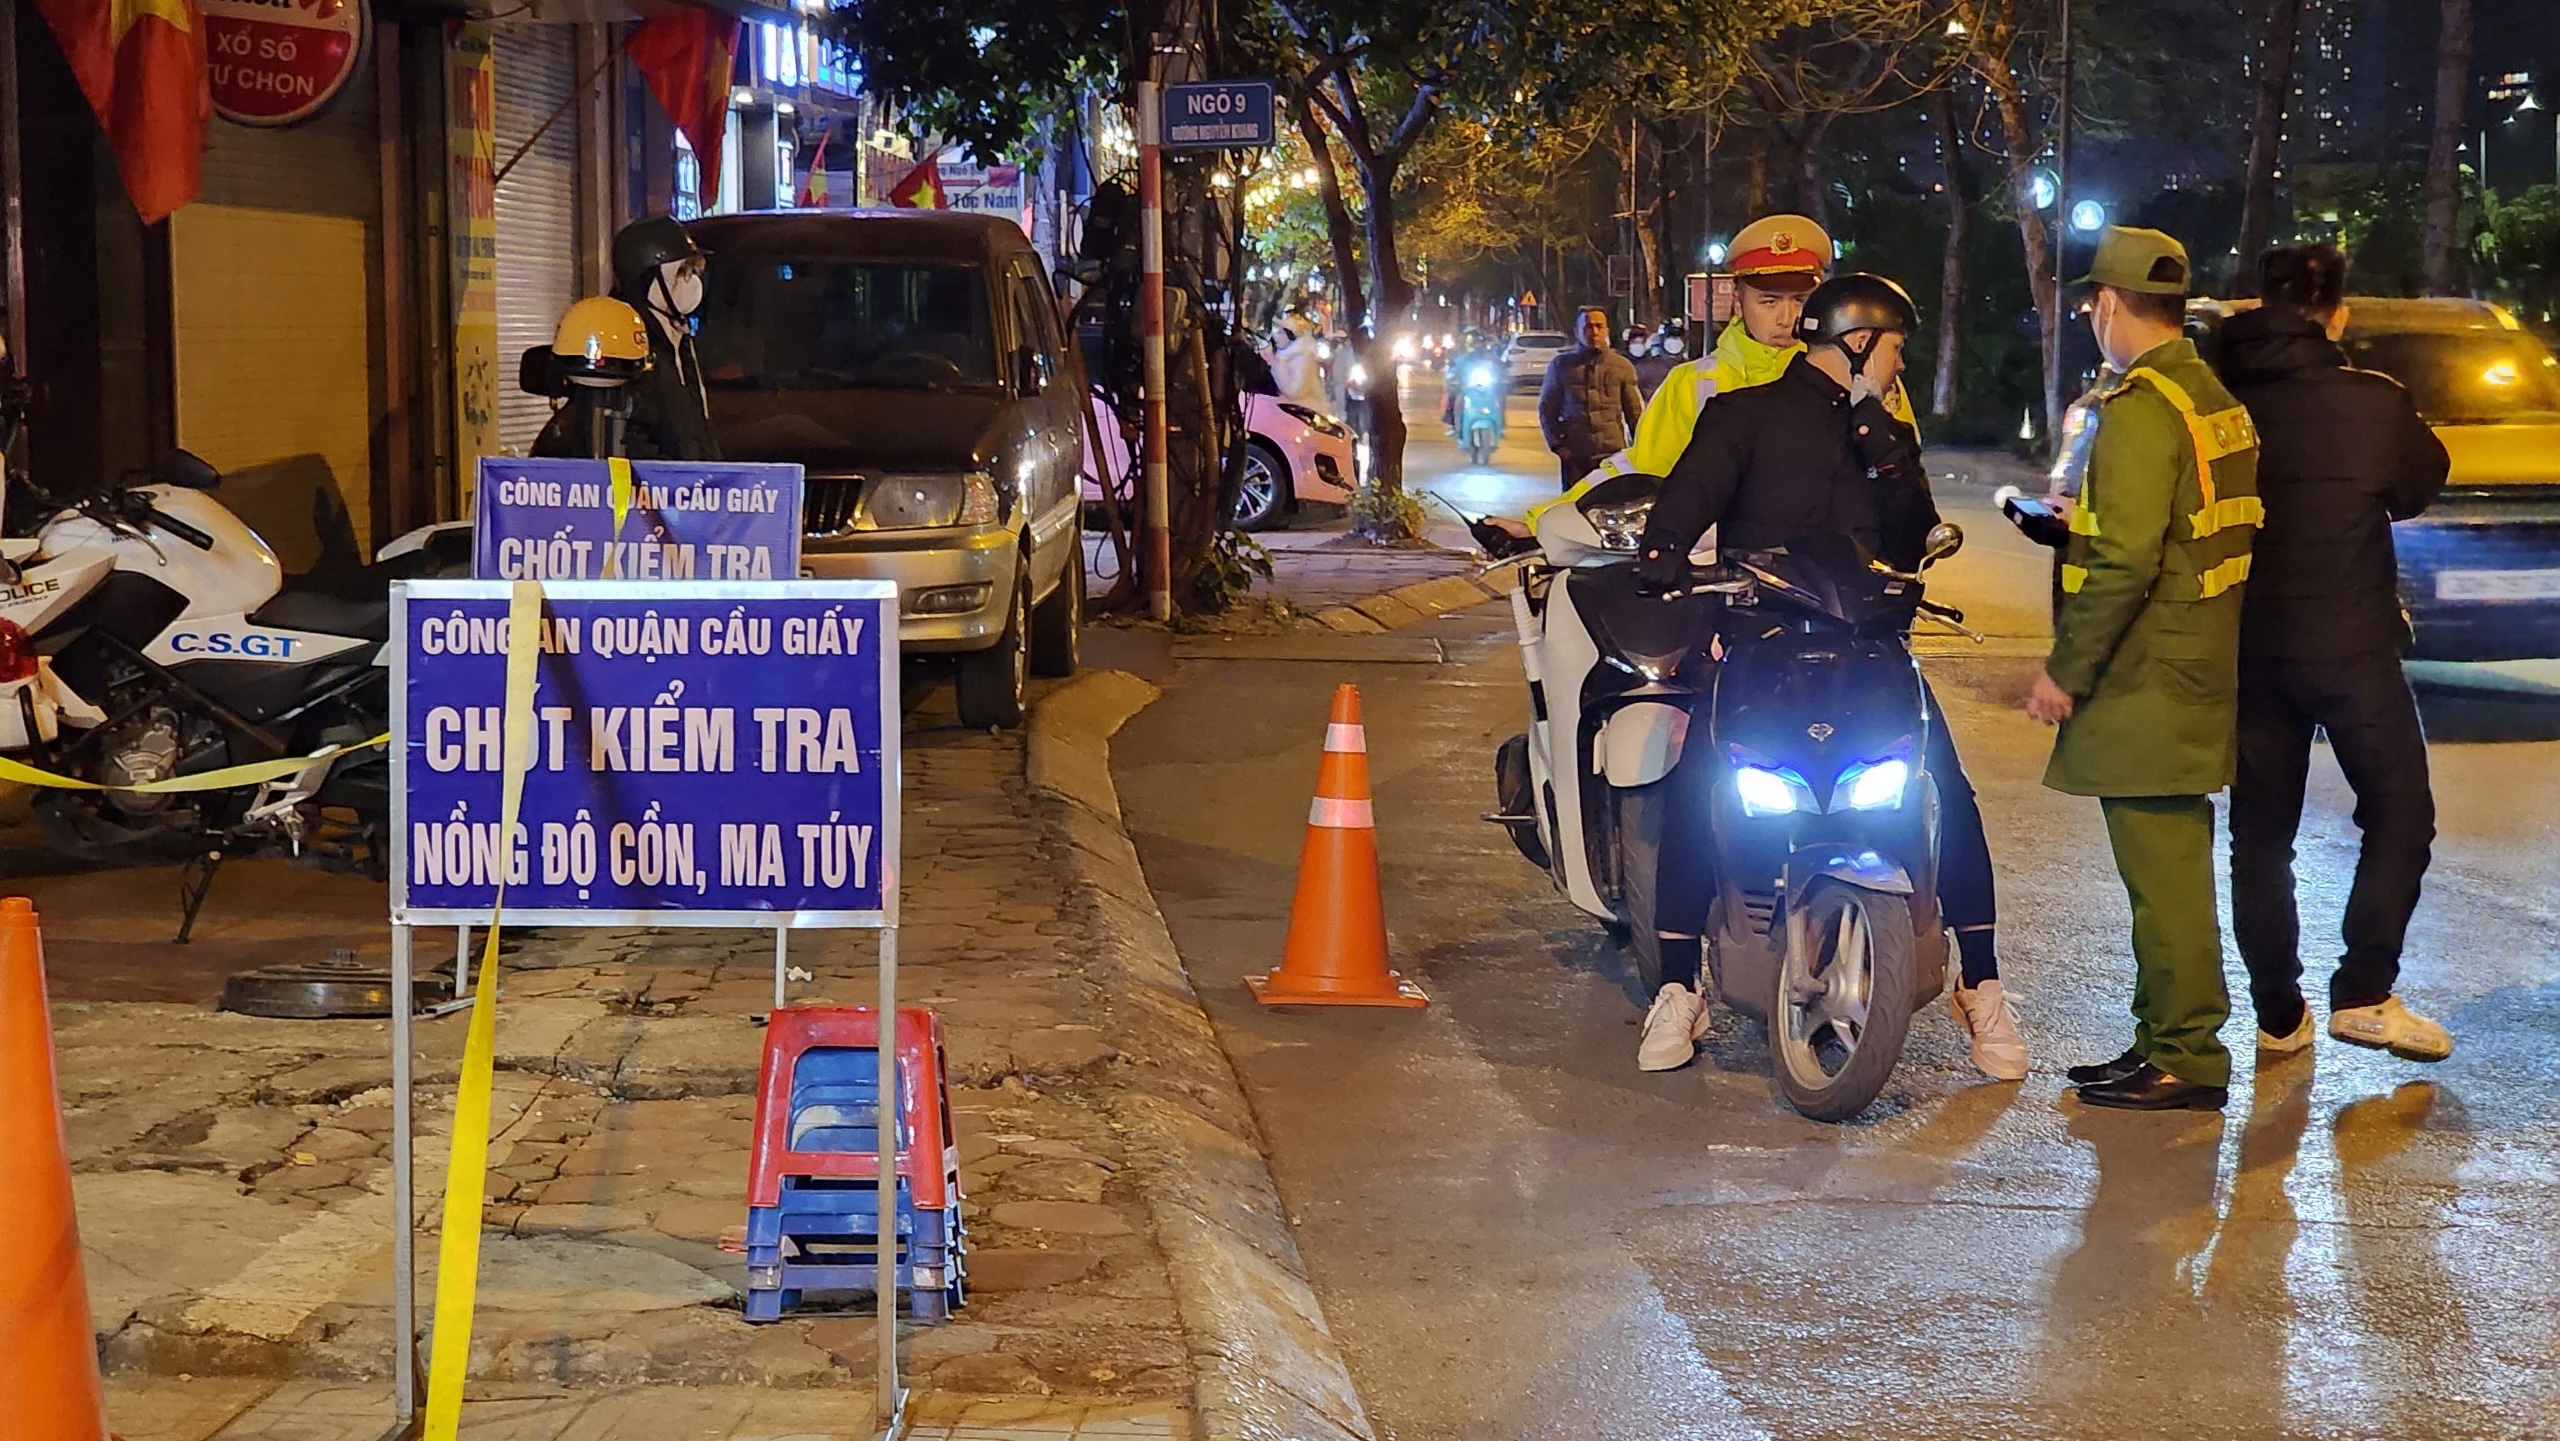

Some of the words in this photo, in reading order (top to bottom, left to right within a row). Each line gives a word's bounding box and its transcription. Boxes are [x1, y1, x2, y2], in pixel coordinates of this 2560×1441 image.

[260, 33, 298, 61] SỐ
[237, 68, 314, 98] CHỌN
[1187, 88, 1231, 115] NGÕ
[1234, 93, 1247, 113] 9
[984, 192, 1018, 209] Nam
[500, 477, 561, 507] CÔNG
[567, 483, 600, 508] AN
[675, 474, 720, 511] CẦU
[727, 480, 779, 513] GIẤY
[500, 525, 592, 580] CHỐT
[603, 525, 695, 580] KIỂM
[707, 544, 772, 580] TRA
[0, 578, 60, 602] OLICE
[171, 633, 296, 658] C.S.G.T
[592, 610, 690, 662] QUẬN
[702, 605, 771, 655] CẦU
[782, 604, 864, 656] GIẤY
[591, 679, 735, 773] KIỂM
[753, 707, 860, 773] TRA
[414, 800, 529, 887] NỒNG
[541, 809, 597, 900] ĐỘ
[610, 801, 707, 895] CỒN,
[720, 823, 786, 888] MA
[797, 811, 873, 889] TÚY
